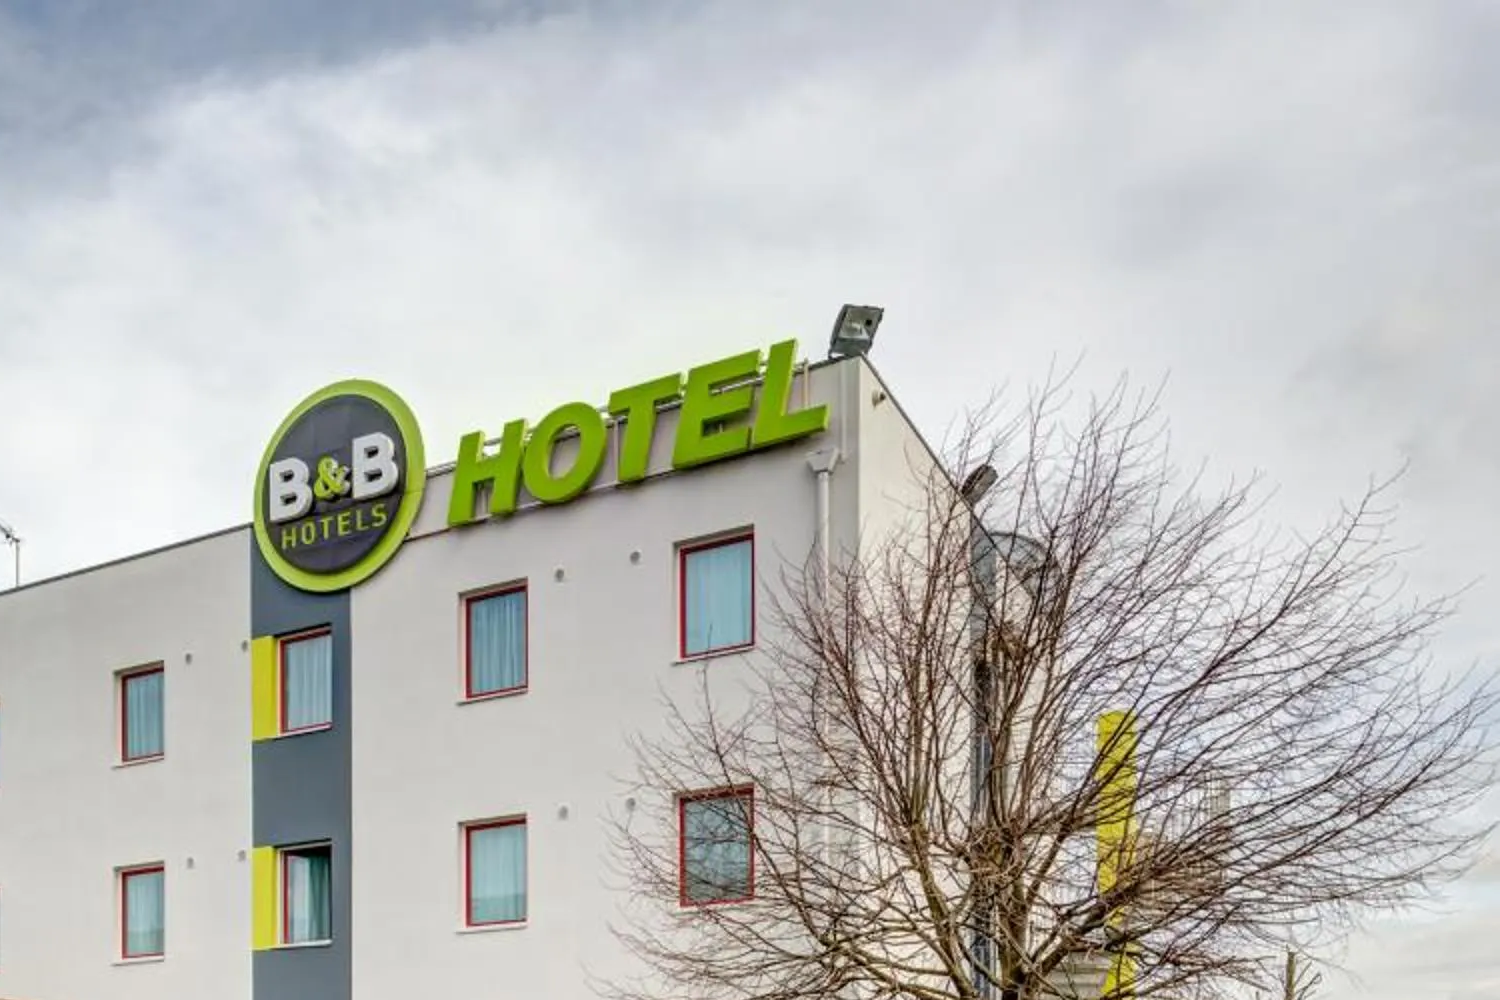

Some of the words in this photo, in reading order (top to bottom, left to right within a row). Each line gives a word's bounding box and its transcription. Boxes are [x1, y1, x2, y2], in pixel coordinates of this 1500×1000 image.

[269, 431, 399, 522] B&B
[447, 338, 830, 527] HOTEL
[281, 503, 388, 550] HOTELS
